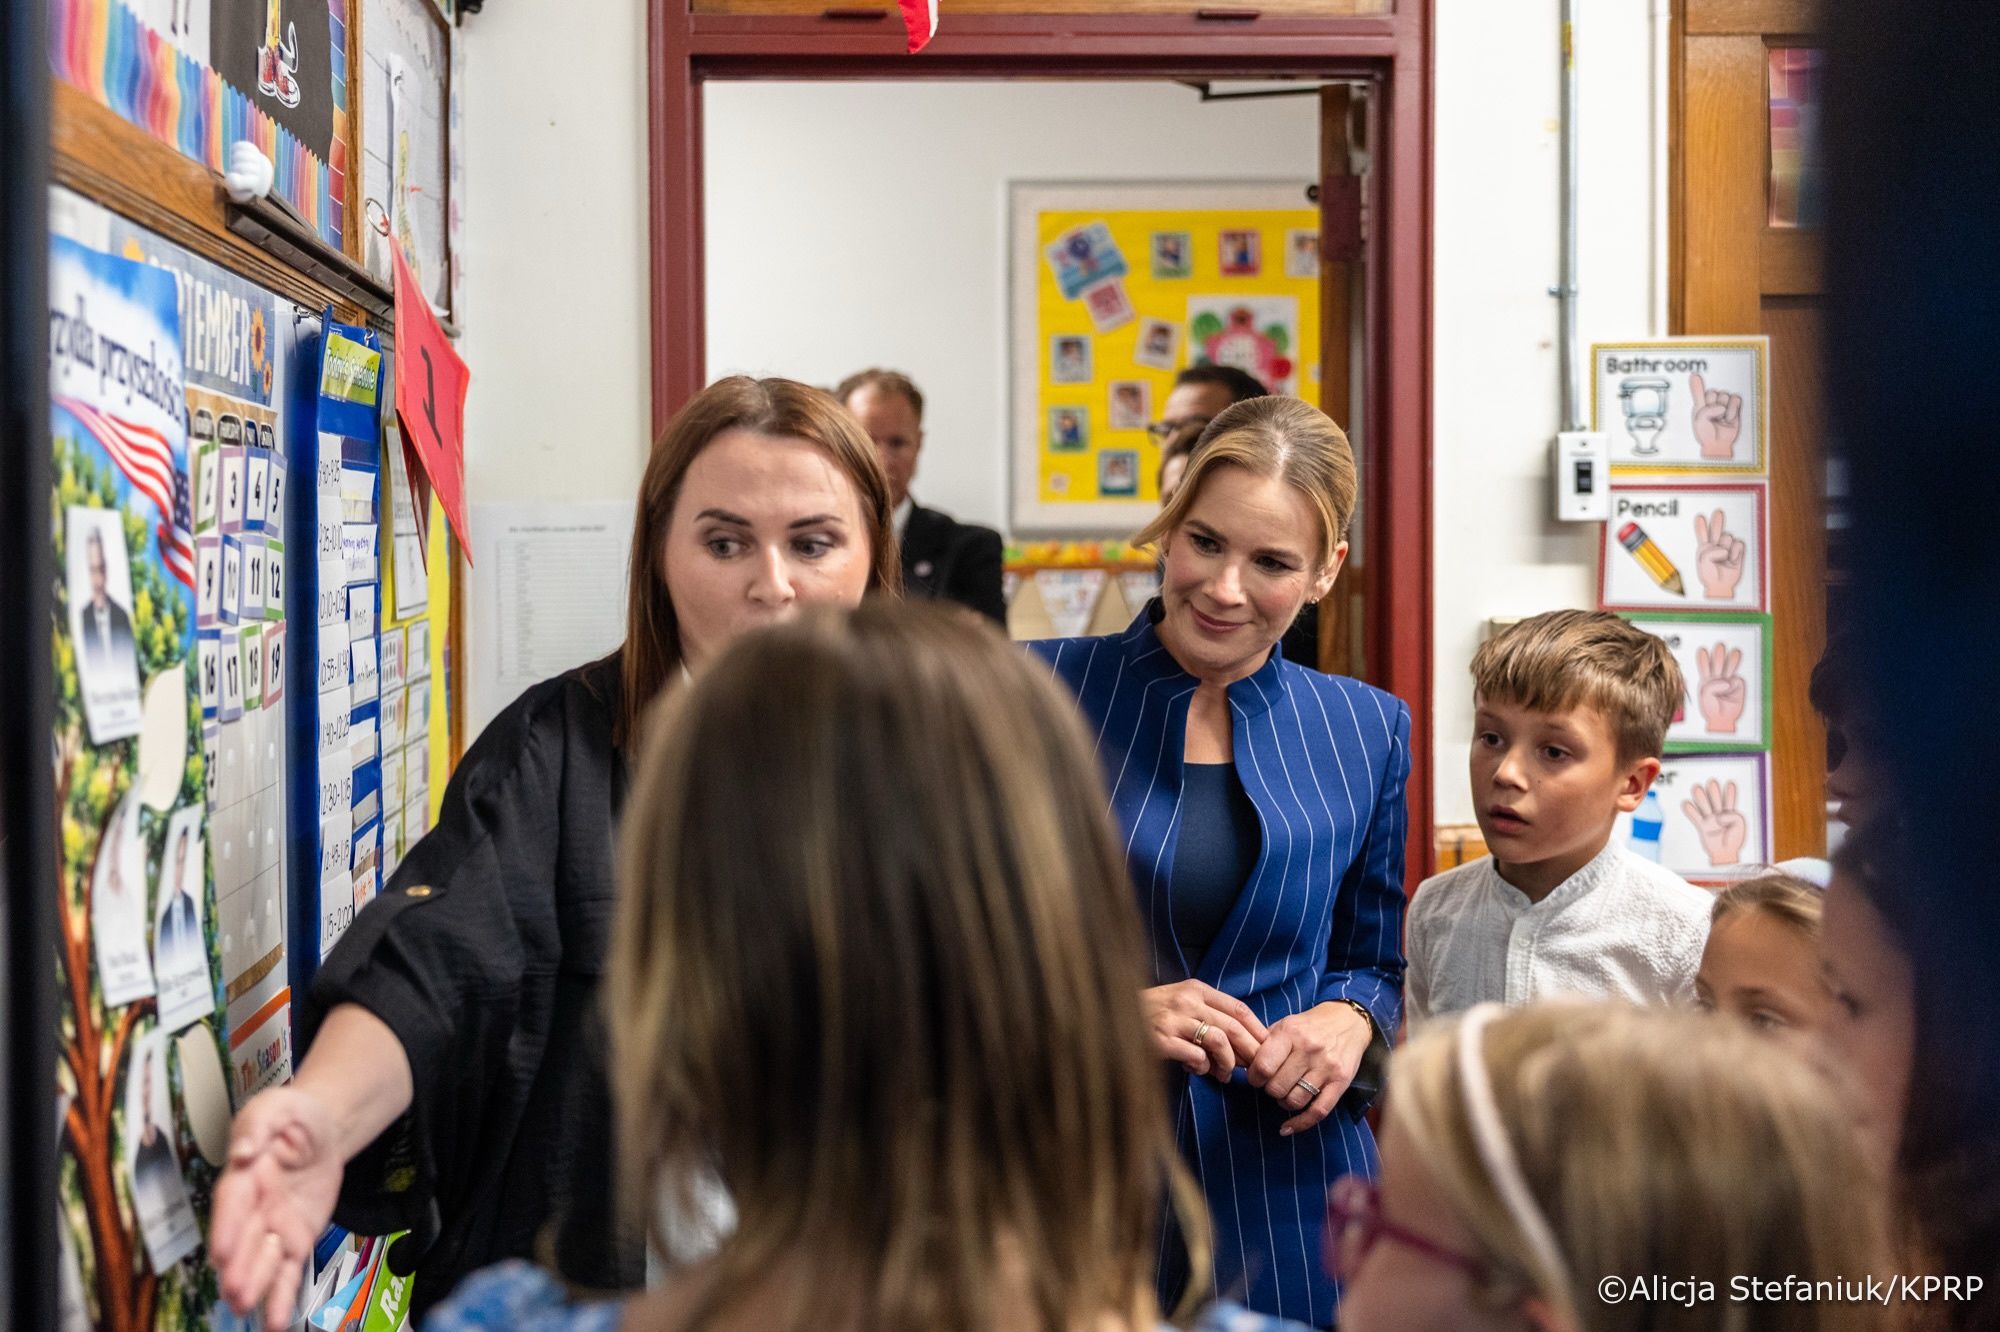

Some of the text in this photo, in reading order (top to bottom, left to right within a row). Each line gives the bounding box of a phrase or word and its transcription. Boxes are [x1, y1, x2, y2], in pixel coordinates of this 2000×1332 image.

[1606, 357, 1708, 374] Bathroom
[230, 471, 238, 509] 3
[254, 471, 262, 508] 4
[272, 477, 280, 513] 5
[1617, 499, 1679, 516] Pencil
[206, 560, 213, 600] 9
[250, 556, 262, 596] 11
[270, 561, 281, 599] 12
[203, 641, 281, 698] 16 17 18 19
